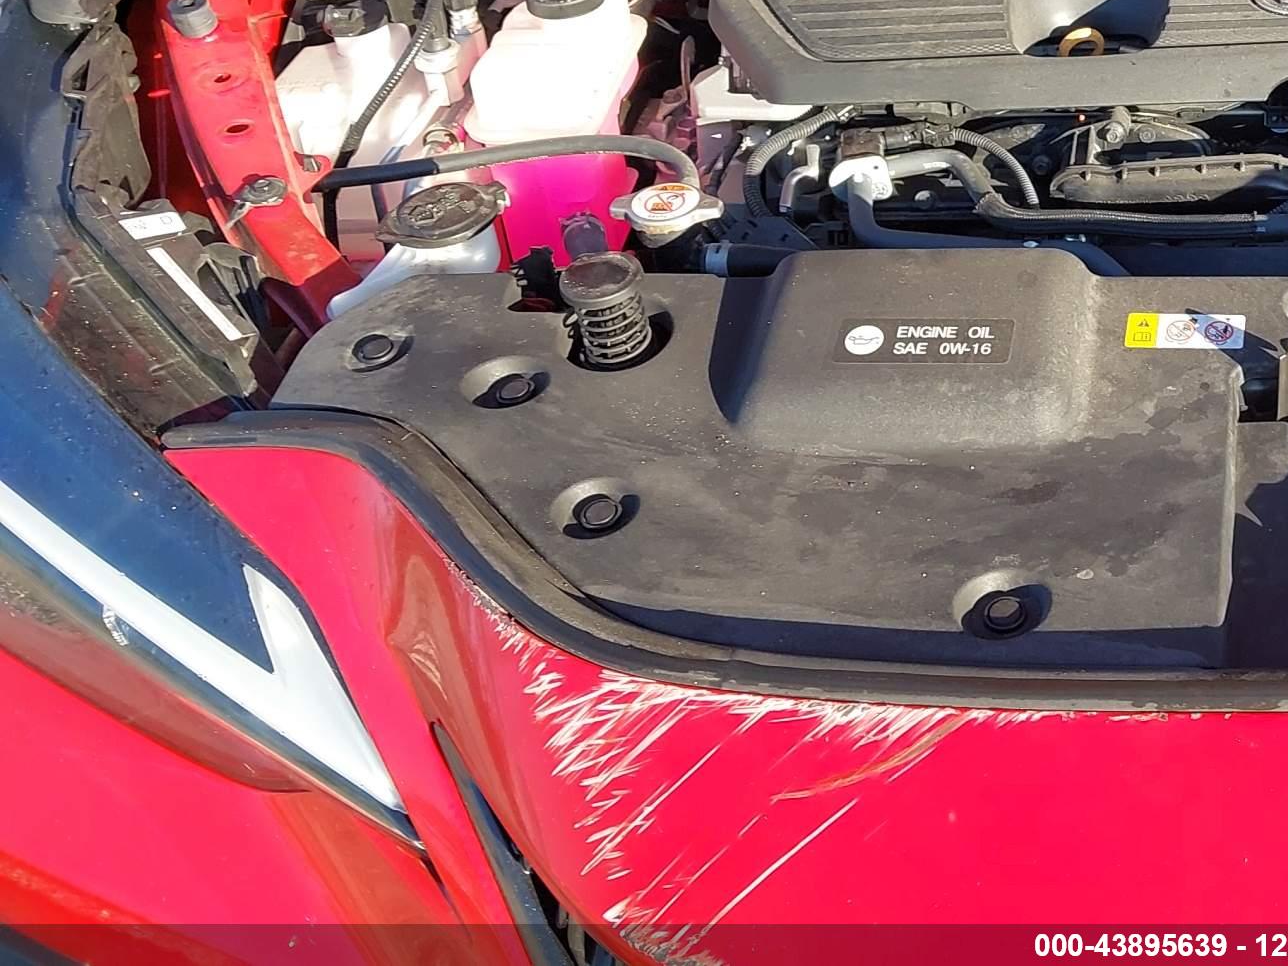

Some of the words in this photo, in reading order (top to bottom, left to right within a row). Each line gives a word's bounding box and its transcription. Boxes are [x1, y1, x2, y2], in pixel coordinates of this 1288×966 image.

[896, 325, 959, 339] ENGINE
[967, 325, 995, 339] OIL
[892, 341, 929, 355] SAE
[939, 342, 992, 355] 0W-16
